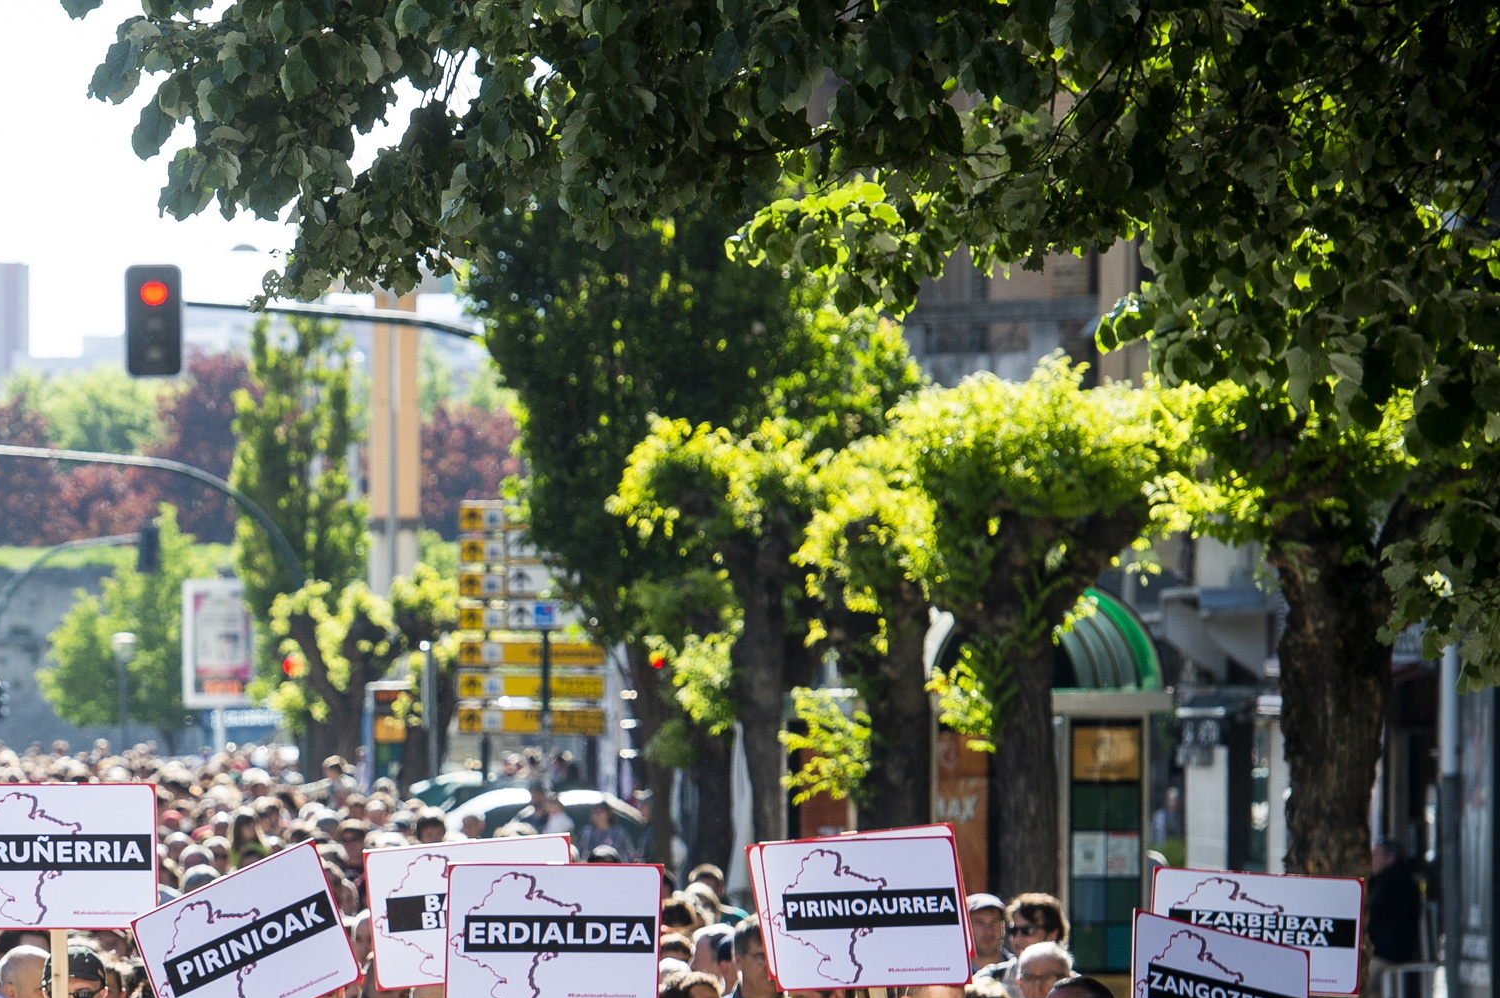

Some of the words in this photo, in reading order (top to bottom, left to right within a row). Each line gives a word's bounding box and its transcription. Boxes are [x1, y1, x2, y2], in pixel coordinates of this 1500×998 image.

[785, 894, 956, 919] PIRINIOAURREA
[468, 920, 652, 946] ERDIALDEA
[1191, 910, 1335, 932] IZARBEIBAR
[176, 901, 326, 985] PIRINIOAK
